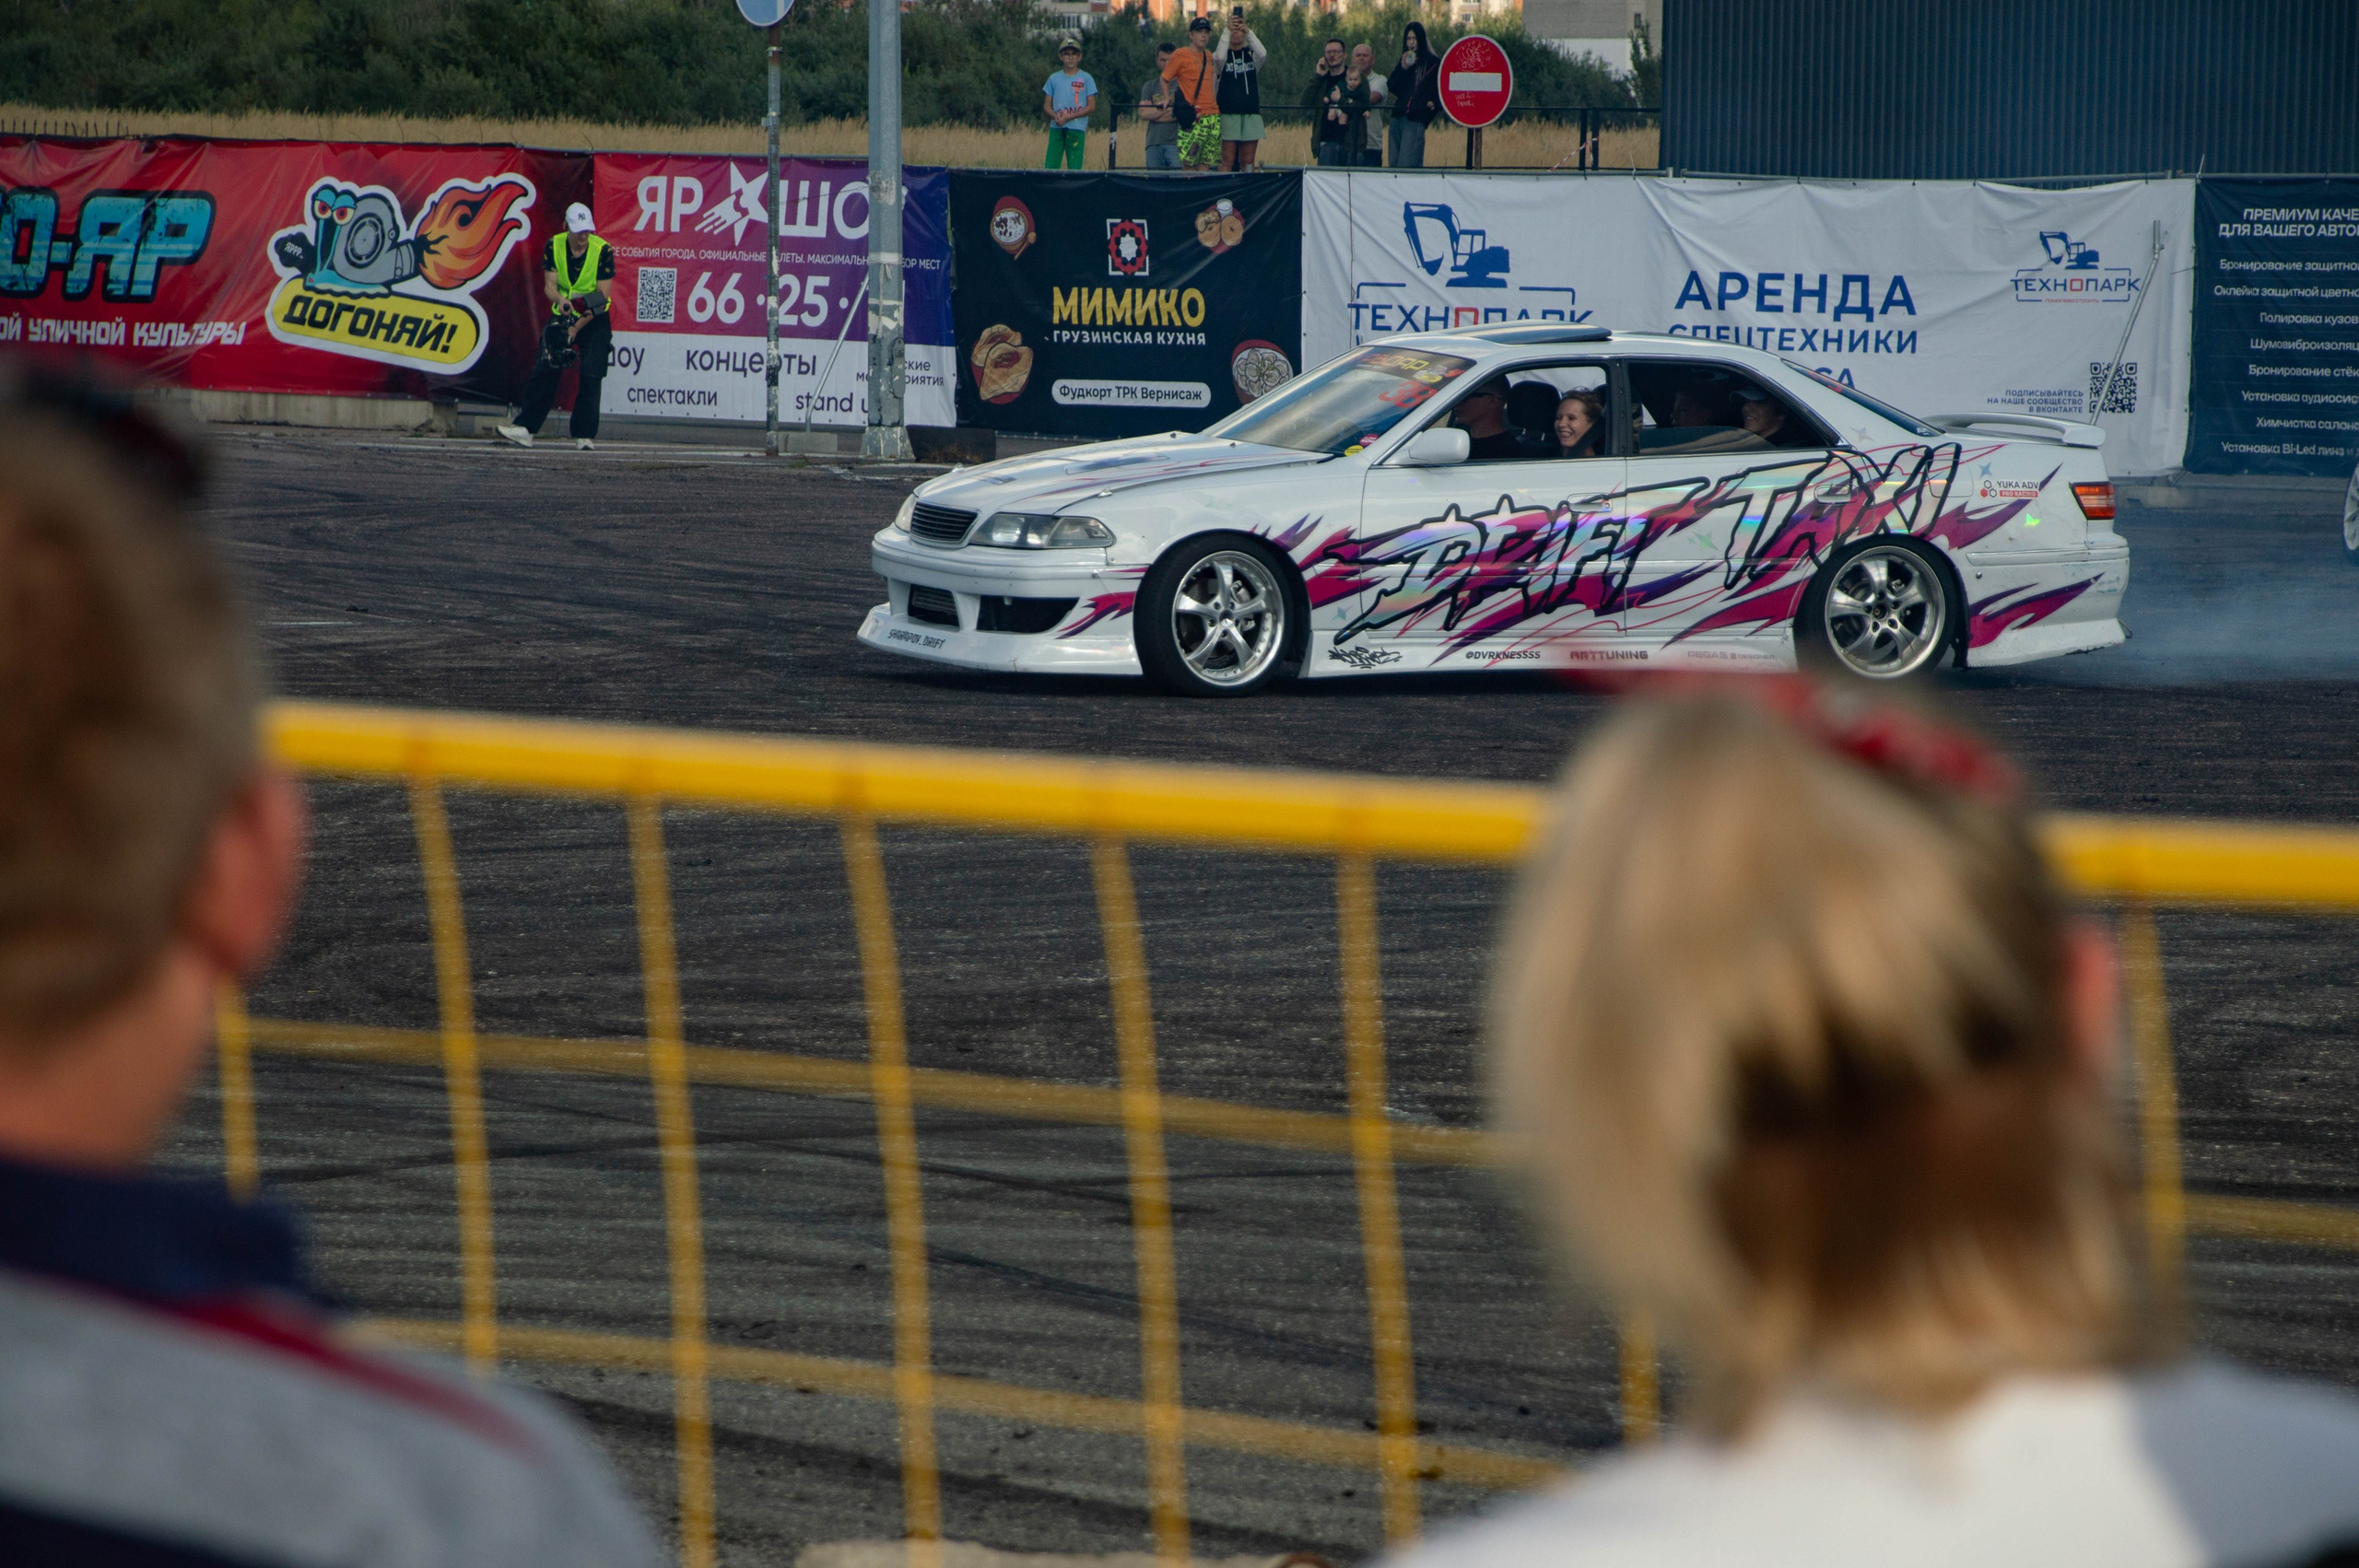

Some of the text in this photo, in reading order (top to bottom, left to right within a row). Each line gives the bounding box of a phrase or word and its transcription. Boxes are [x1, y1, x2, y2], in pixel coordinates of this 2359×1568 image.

[632, 175, 908, 240] ЯР ШО
[2244, 208, 2319, 221] ПРЕМИУМ
[2219, 224, 2359, 238] ДЛЯ ВАШЕГО АВТО
[0, 187, 217, 303] О-ЯР
[621, 247, 660, 258] СОБЫТИЯ
[662, 249, 697, 260] ГОРОДА.
[699, 250, 767, 262] ОФИЦИАЛЬНЫЕ
[778, 252, 805, 264] ЛЕТЫ.
[807, 253, 869, 265] МАКСИМАЛЬН
[919, 259, 941, 270] МЕСТ
[2220, 259, 2303, 272] Бронирование
[2010, 278, 2142, 292] ТЕХНОПАРК
[2214, 285, 2259, 296] Оклейка
[2261, 286, 2318, 298] защитной
[1674, 270, 1917, 322] АРЕНДА
[1052, 287, 1205, 327] МИМИКО
[282, 295, 458, 354] ДОГОНЯЙ!
[2260, 312, 2323, 324] Полировка
[29, 317, 125, 345] УЛИЧНОЙ
[133, 322, 247, 347] КУЛЬТУРЫ
[1053, 330, 1206, 345] ГРУЗИНСКАЯ КУХНЯ
[2248, 364, 2331, 377] Бронирование
[628, 387, 718, 405] спектакли
[1060, 384, 1202, 402] Фудкорт ТРК Вернисаж
[1379, 380, 1438, 408] 38
[2005, 389, 2083, 397] ПОДПИСЫВАЙТЕСЬ
[2242, 390, 2359, 404] Установка аудиосис
[795, 392, 853, 412] stand
[2001, 397, 2025, 405] НАШЕ
[2256, 416, 2316, 428] Химчистка
[2222, 441, 2281, 453] Установка
[1997, 480, 2038, 489] YUKA ADV
